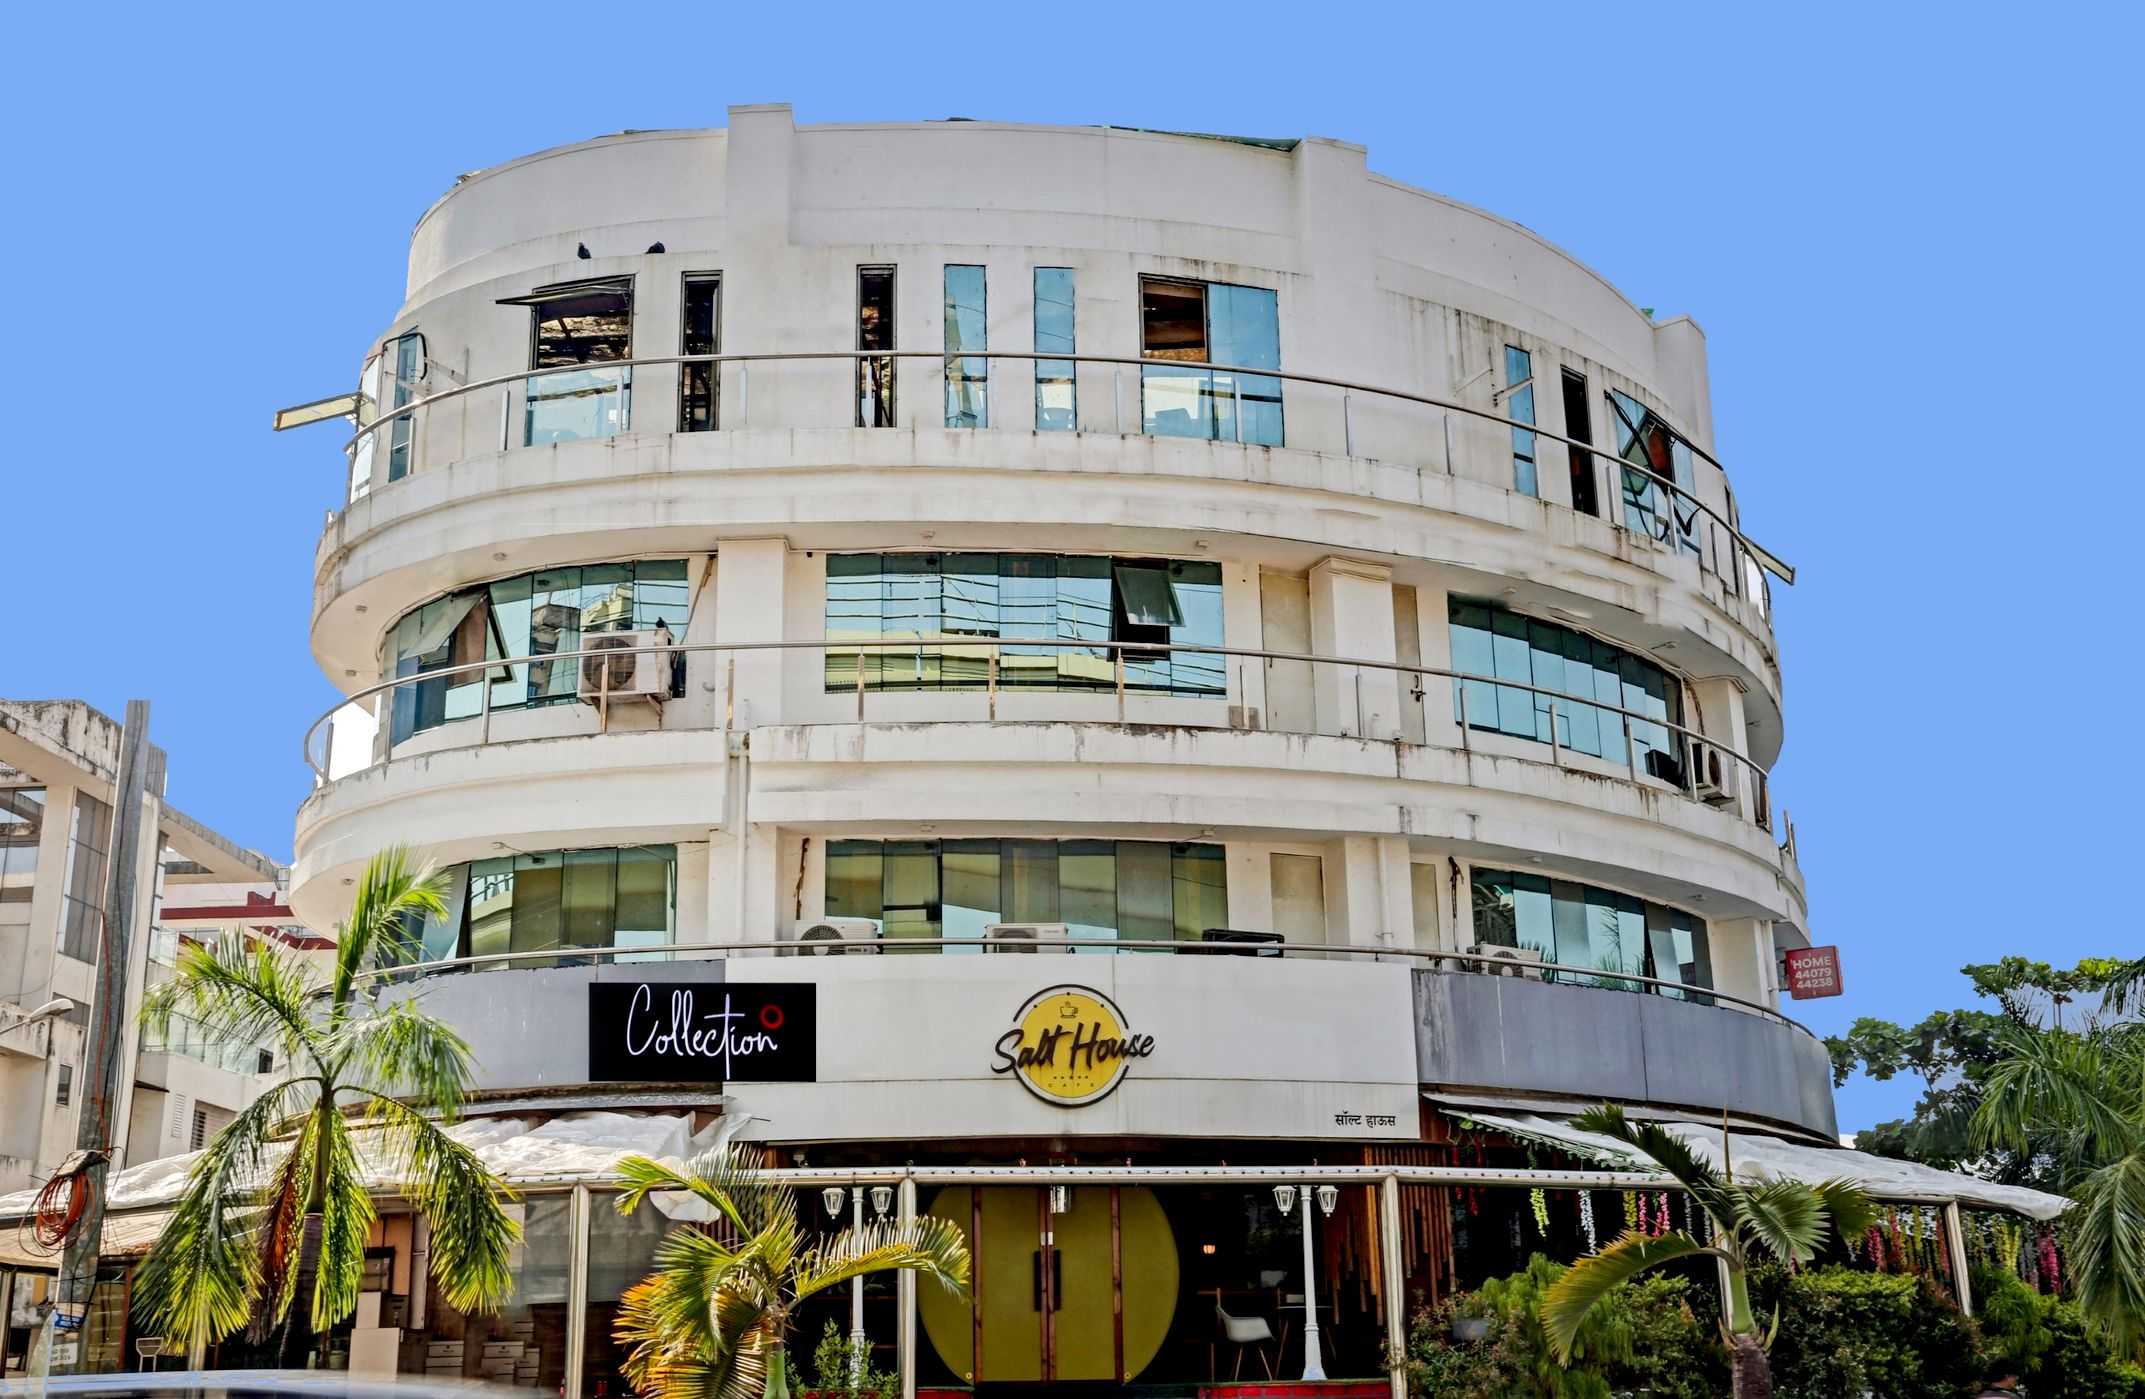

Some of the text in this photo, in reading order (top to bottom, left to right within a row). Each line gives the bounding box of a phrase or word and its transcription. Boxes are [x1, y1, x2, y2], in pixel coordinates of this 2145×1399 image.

[1792, 956, 1832, 970] HOME
[626, 984, 778, 1081] Collection
[991, 1022, 1156, 1074] Salt House
[1334, 1110, 1396, 1129] सॉल्ट हाऊस
